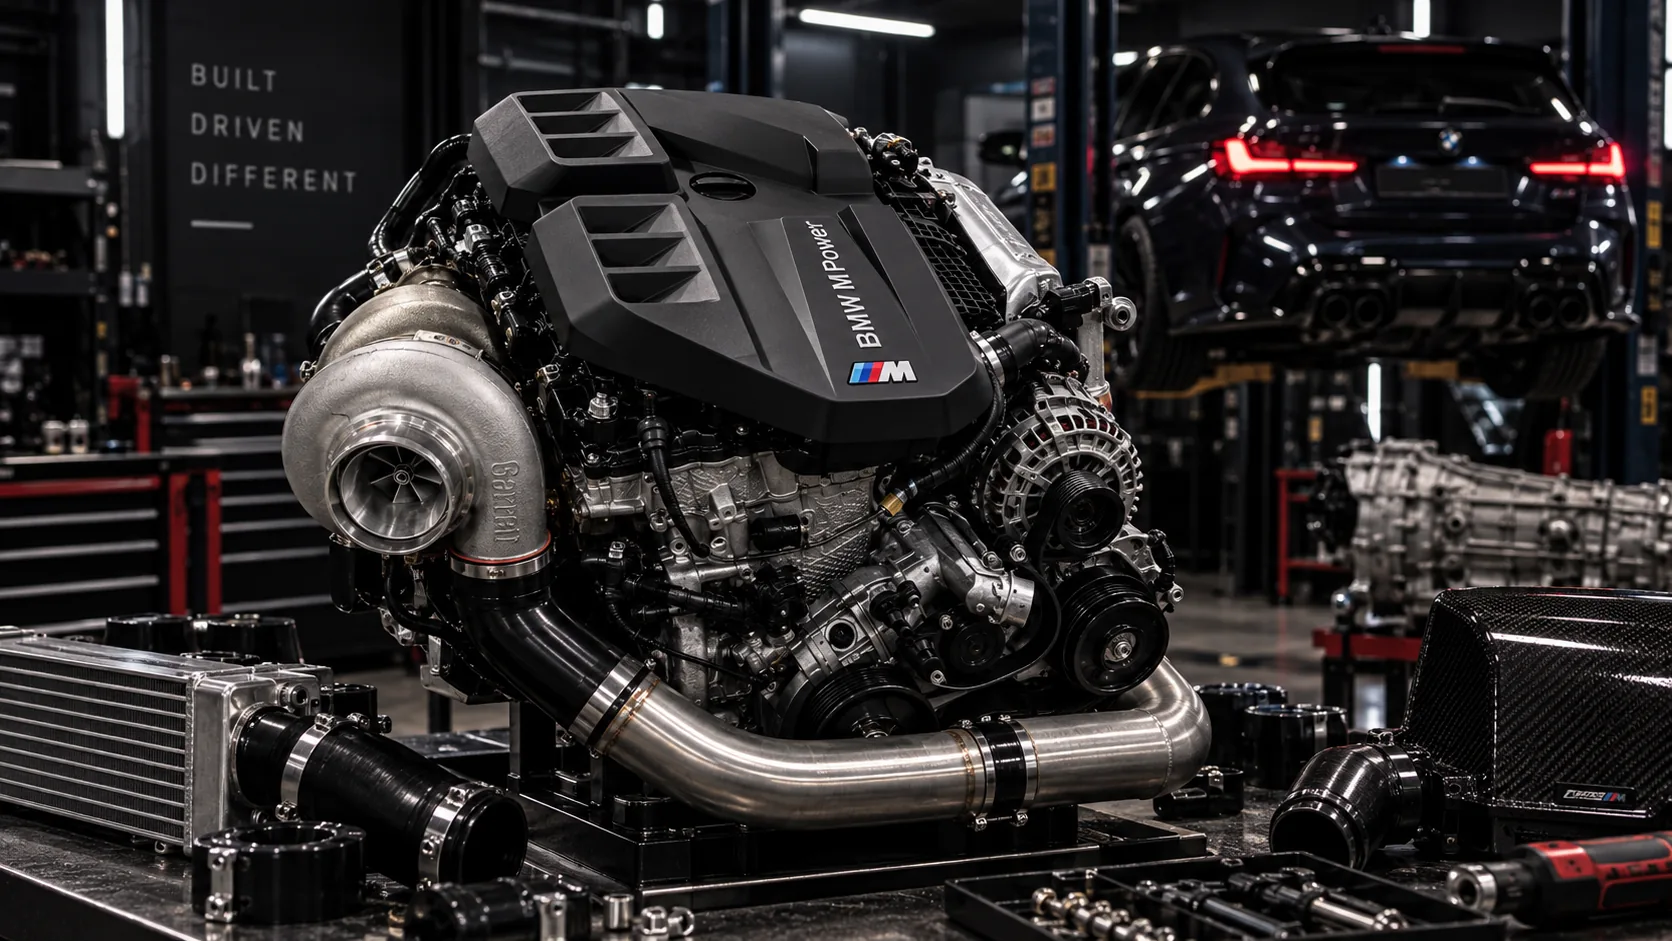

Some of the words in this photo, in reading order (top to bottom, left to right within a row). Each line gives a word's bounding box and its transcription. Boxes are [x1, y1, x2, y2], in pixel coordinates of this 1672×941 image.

[191, 63, 276, 92] BUILT
[191, 112, 303, 142] DRIVEN
[191, 161, 356, 193] DIFFERENT
[837, 294, 882, 348] BMW
[878, 361, 917, 382] M
